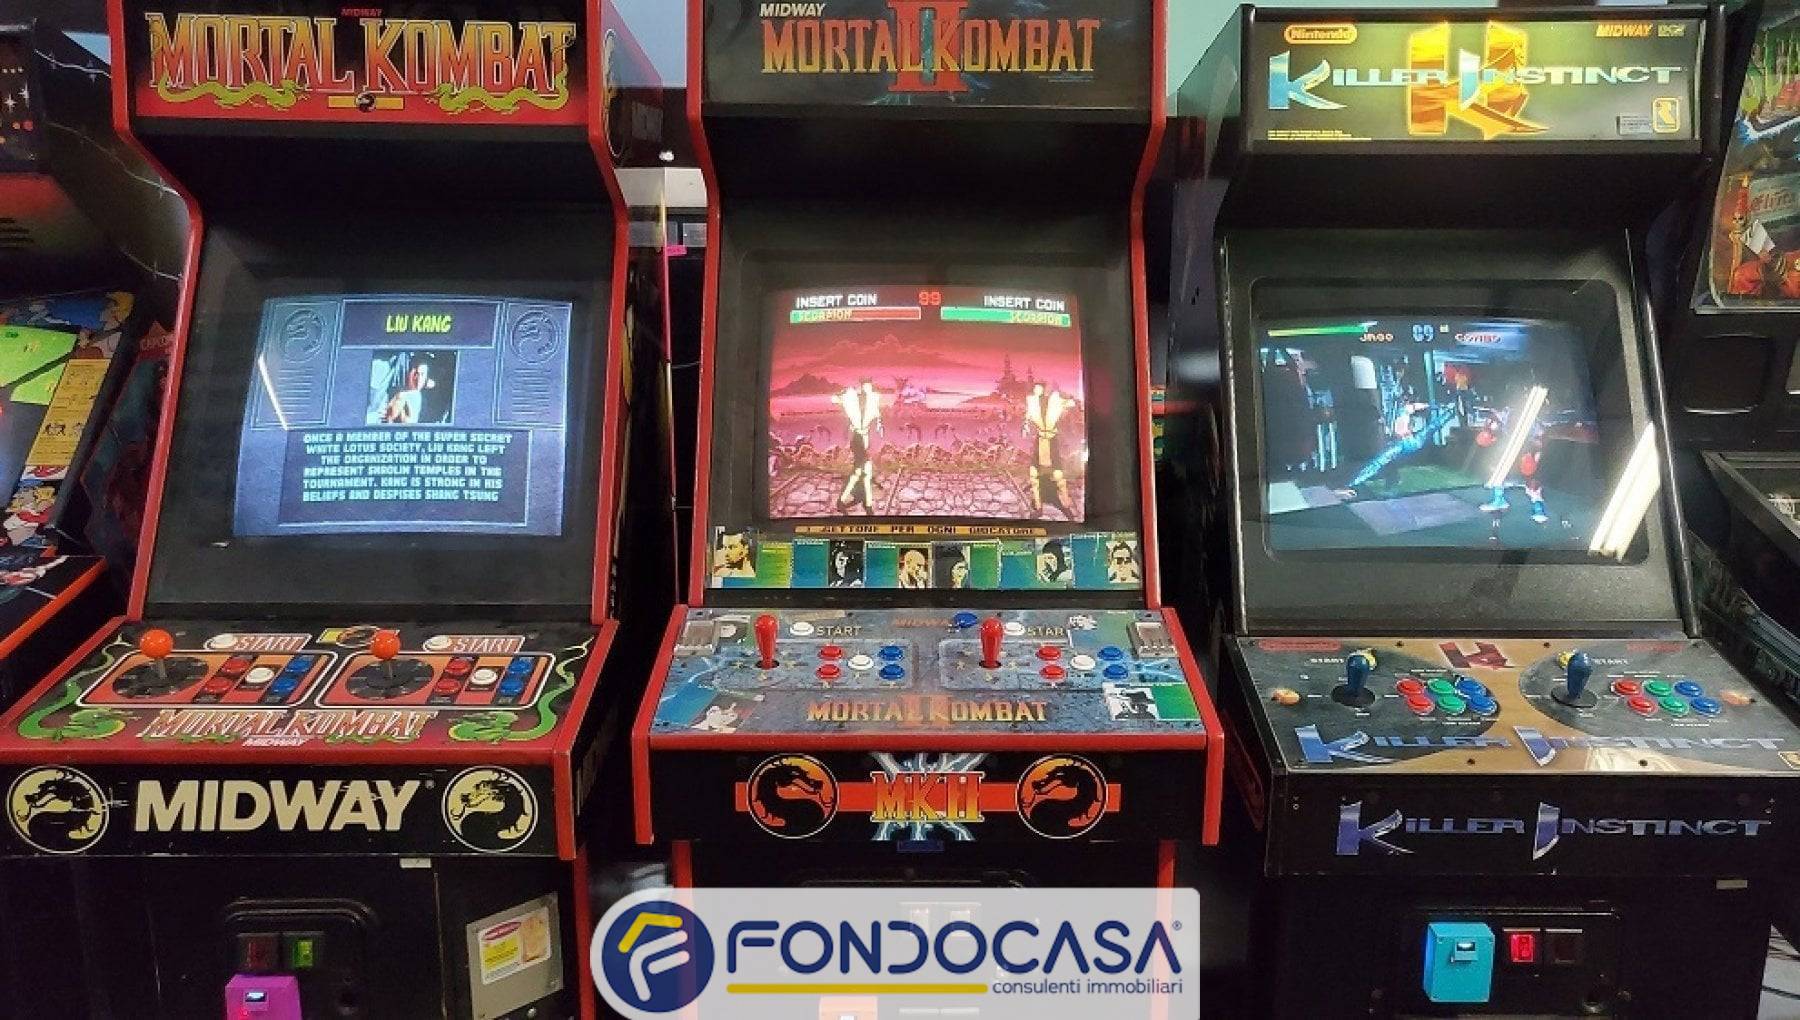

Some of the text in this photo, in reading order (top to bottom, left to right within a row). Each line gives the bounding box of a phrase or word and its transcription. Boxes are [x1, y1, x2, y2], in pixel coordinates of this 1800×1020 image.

[760, 2, 826, 18] MIDWAY
[1291, 29, 1353, 39] Nintendo
[1596, 24, 1654, 37] MIDWAY
[761, 19, 1101, 74] MORTAL KOMBAT
[145, 12, 577, 97] MORTAL KOMBAT
[1268, 48, 1682, 111] KILLER INSTINCT
[796, 293, 878, 308] INSERT COIN
[983, 295, 1065, 311] INSERT COIN
[386, 315, 452, 333] LIU KANG
[303, 432, 513, 444] ONCE A MEMBER OF THE SUPER SECRET
[306, 444, 341, 455] WHITE
[343, 443, 377, 453] LOTUS
[428, 443, 444, 453] LIU
[446, 443, 475, 453] KANG
[477, 444, 506, 455] LEFT
[320, 454, 488, 466] THE ORGANIZATION IN ORDER TO
[303, 466, 366, 477] REPRESENT
[413, 465, 462, 475] TEMPLES
[464, 466, 477, 476] IN
[480, 466, 502, 477] THE
[380, 477, 408, 487] KANG
[410, 477, 422, 487] IS
[424, 477, 466, 487] STRONG
[468, 477, 481, 488] IN
[484, 478, 503, 489] HIS
[302, 489, 499, 502] BELIEFS AND DESPISES SHANG TSUNG
[816, 625, 862, 637] START
[1026, 626, 1064, 637] STAR
[232, 636, 305, 651] START
[452, 638, 516, 653] START
[806, 699, 1047, 722] MORTAL KOMBAT
[137, 709, 439, 740] MORTAL KOMBAT
[1294, 724, 1786, 767] KILLER INSTINCT
[870, 771, 985, 823] MKII
[135, 780, 421, 832] MIDWAY
[1335, 801, 1772, 861] KILLER INSTINCT
